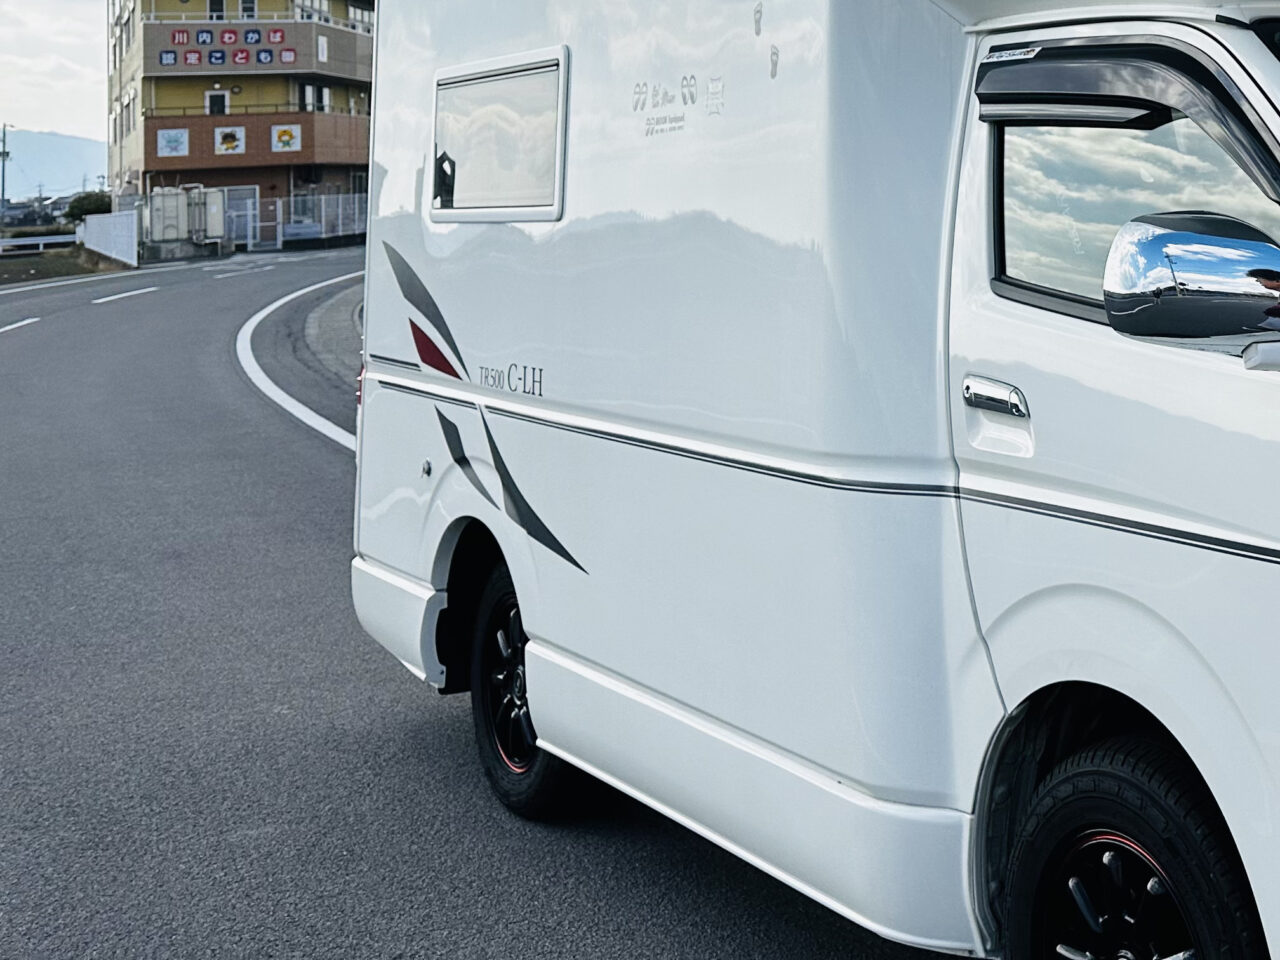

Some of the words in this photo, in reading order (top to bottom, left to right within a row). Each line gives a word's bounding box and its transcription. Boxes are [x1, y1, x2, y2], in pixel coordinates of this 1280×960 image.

[173, 30, 283, 45] 川内わかば
[479, 366, 505, 390] TR500
[507, 362, 544, 397] C-LH
